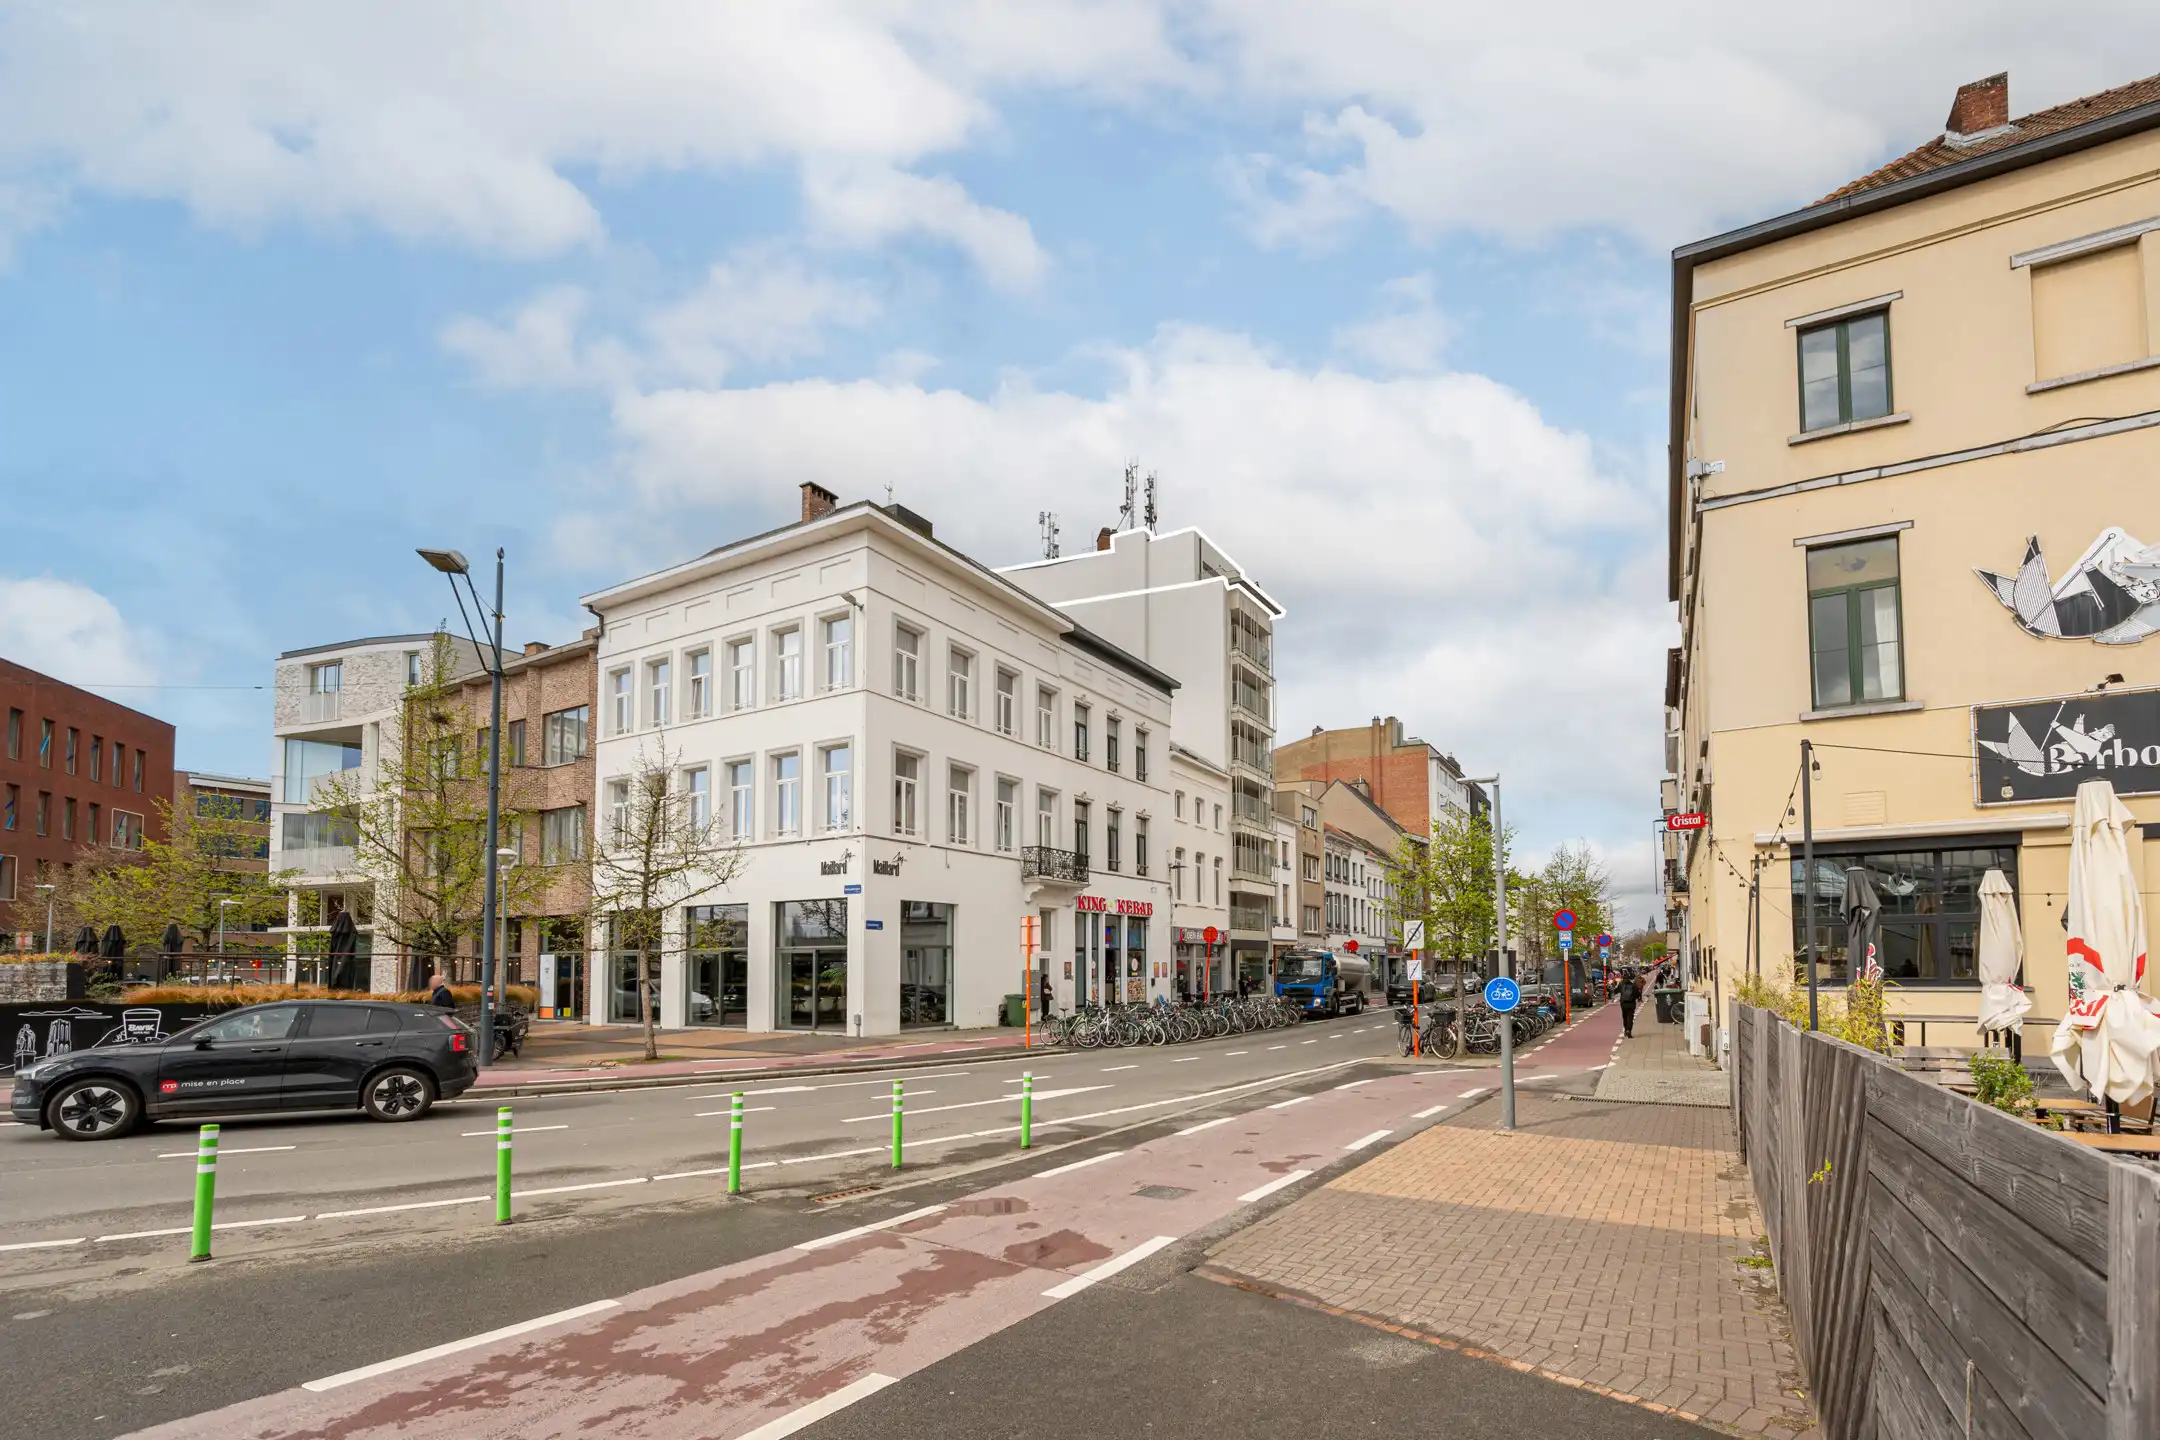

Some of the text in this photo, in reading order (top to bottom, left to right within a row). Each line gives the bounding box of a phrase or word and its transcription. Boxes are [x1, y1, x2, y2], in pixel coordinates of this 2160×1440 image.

[1672, 815, 1701, 827] Cristal
[821, 860, 847, 875] Maillard
[873, 860, 899, 876] Maillard
[1078, 896, 1153, 916] KING KEBAB
